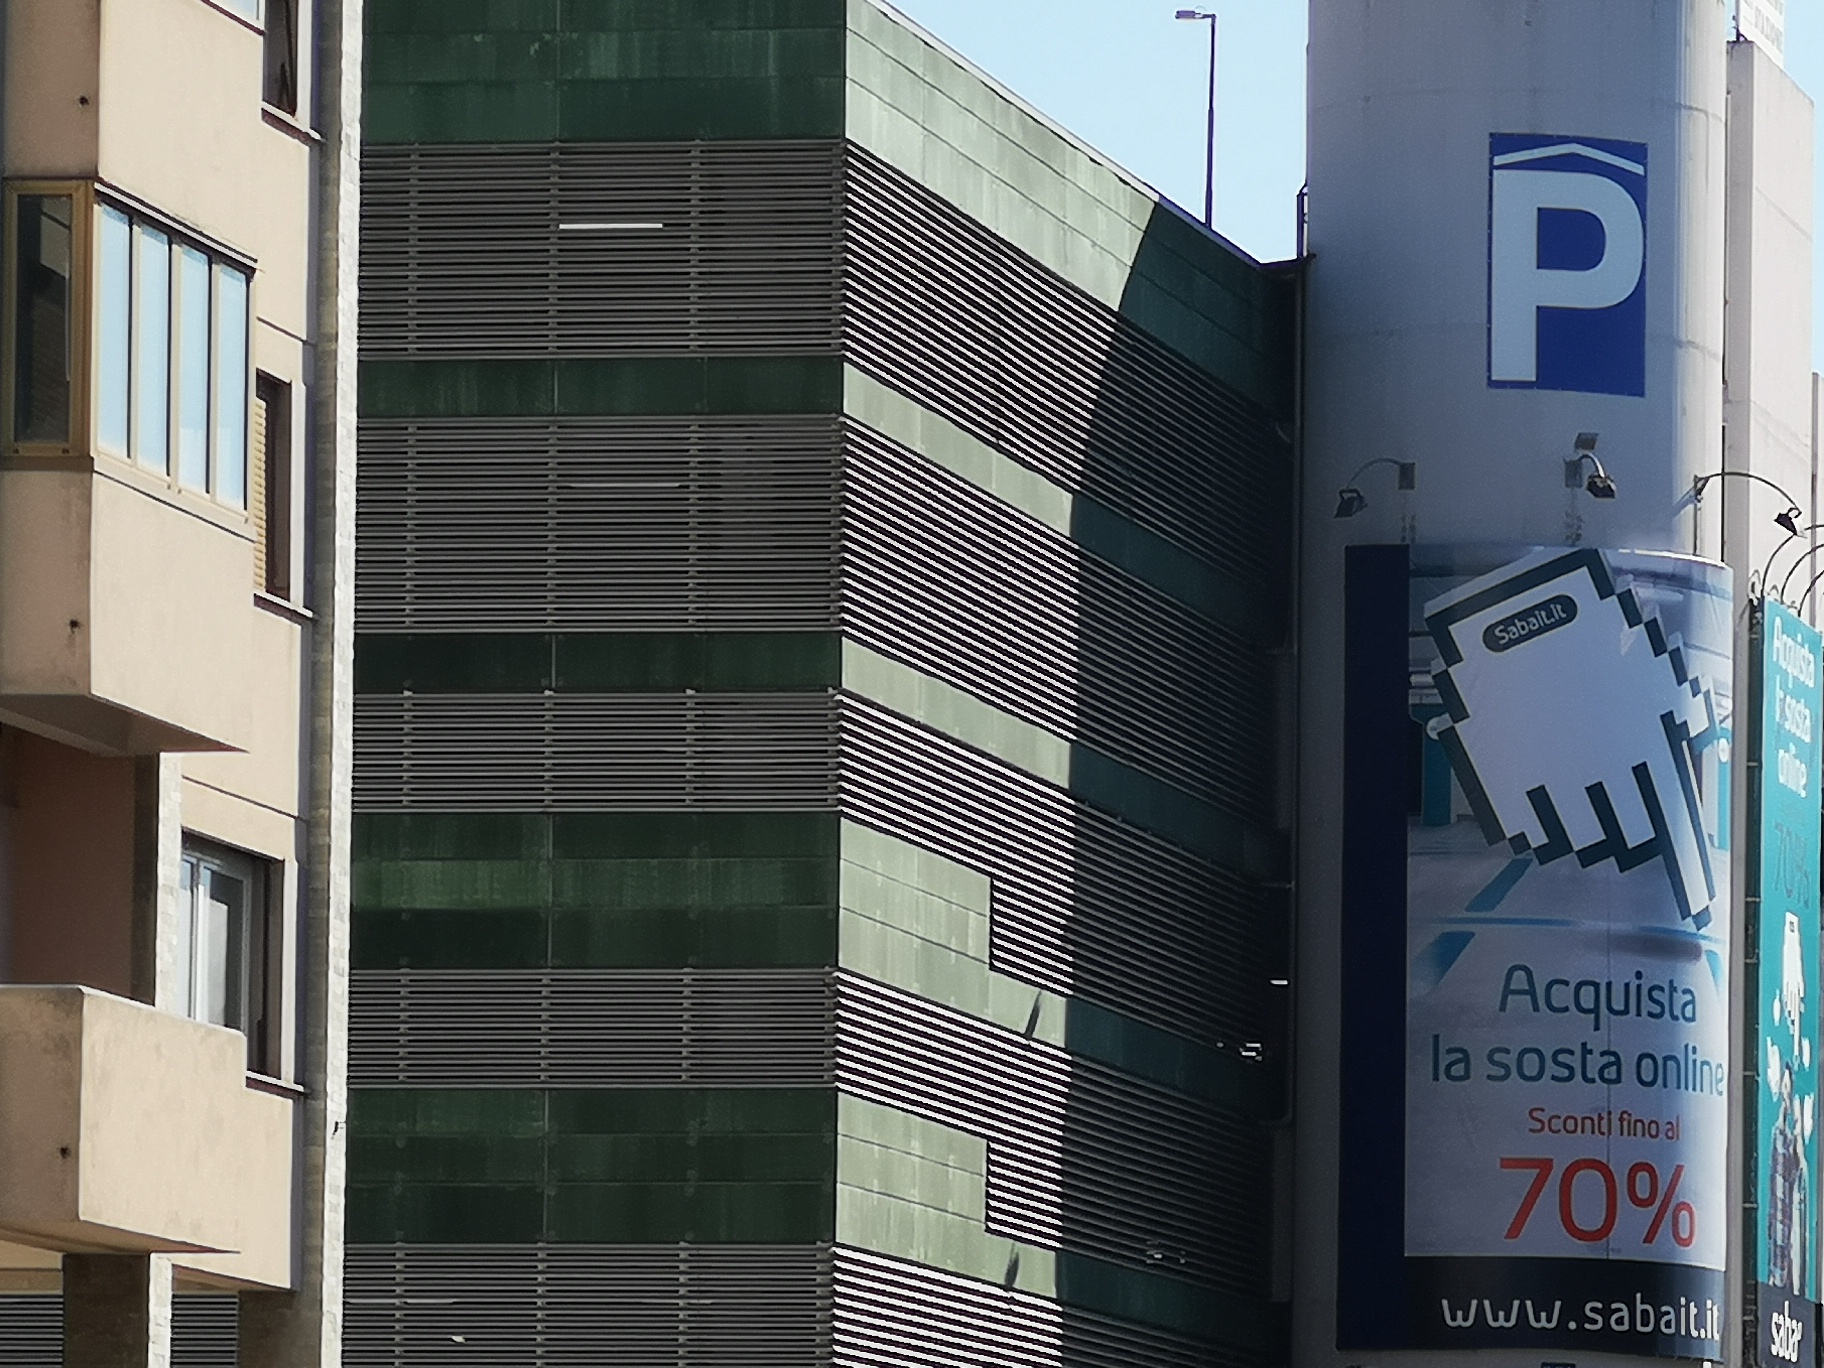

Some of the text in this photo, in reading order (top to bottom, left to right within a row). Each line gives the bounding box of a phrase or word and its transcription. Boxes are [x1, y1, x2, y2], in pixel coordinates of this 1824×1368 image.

[1491, 168, 1645, 382] P
[1493, 604, 1567, 645] Sabait.it
[1498, 963, 1697, 1031] Acquista
[1432, 1035, 1725, 1095] la sosta online
[1528, 1107, 1681, 1141] Sconti fino al
[1499, 1157, 1696, 1247] 70%
[1441, 1291, 1721, 1341] www.sabait.it
